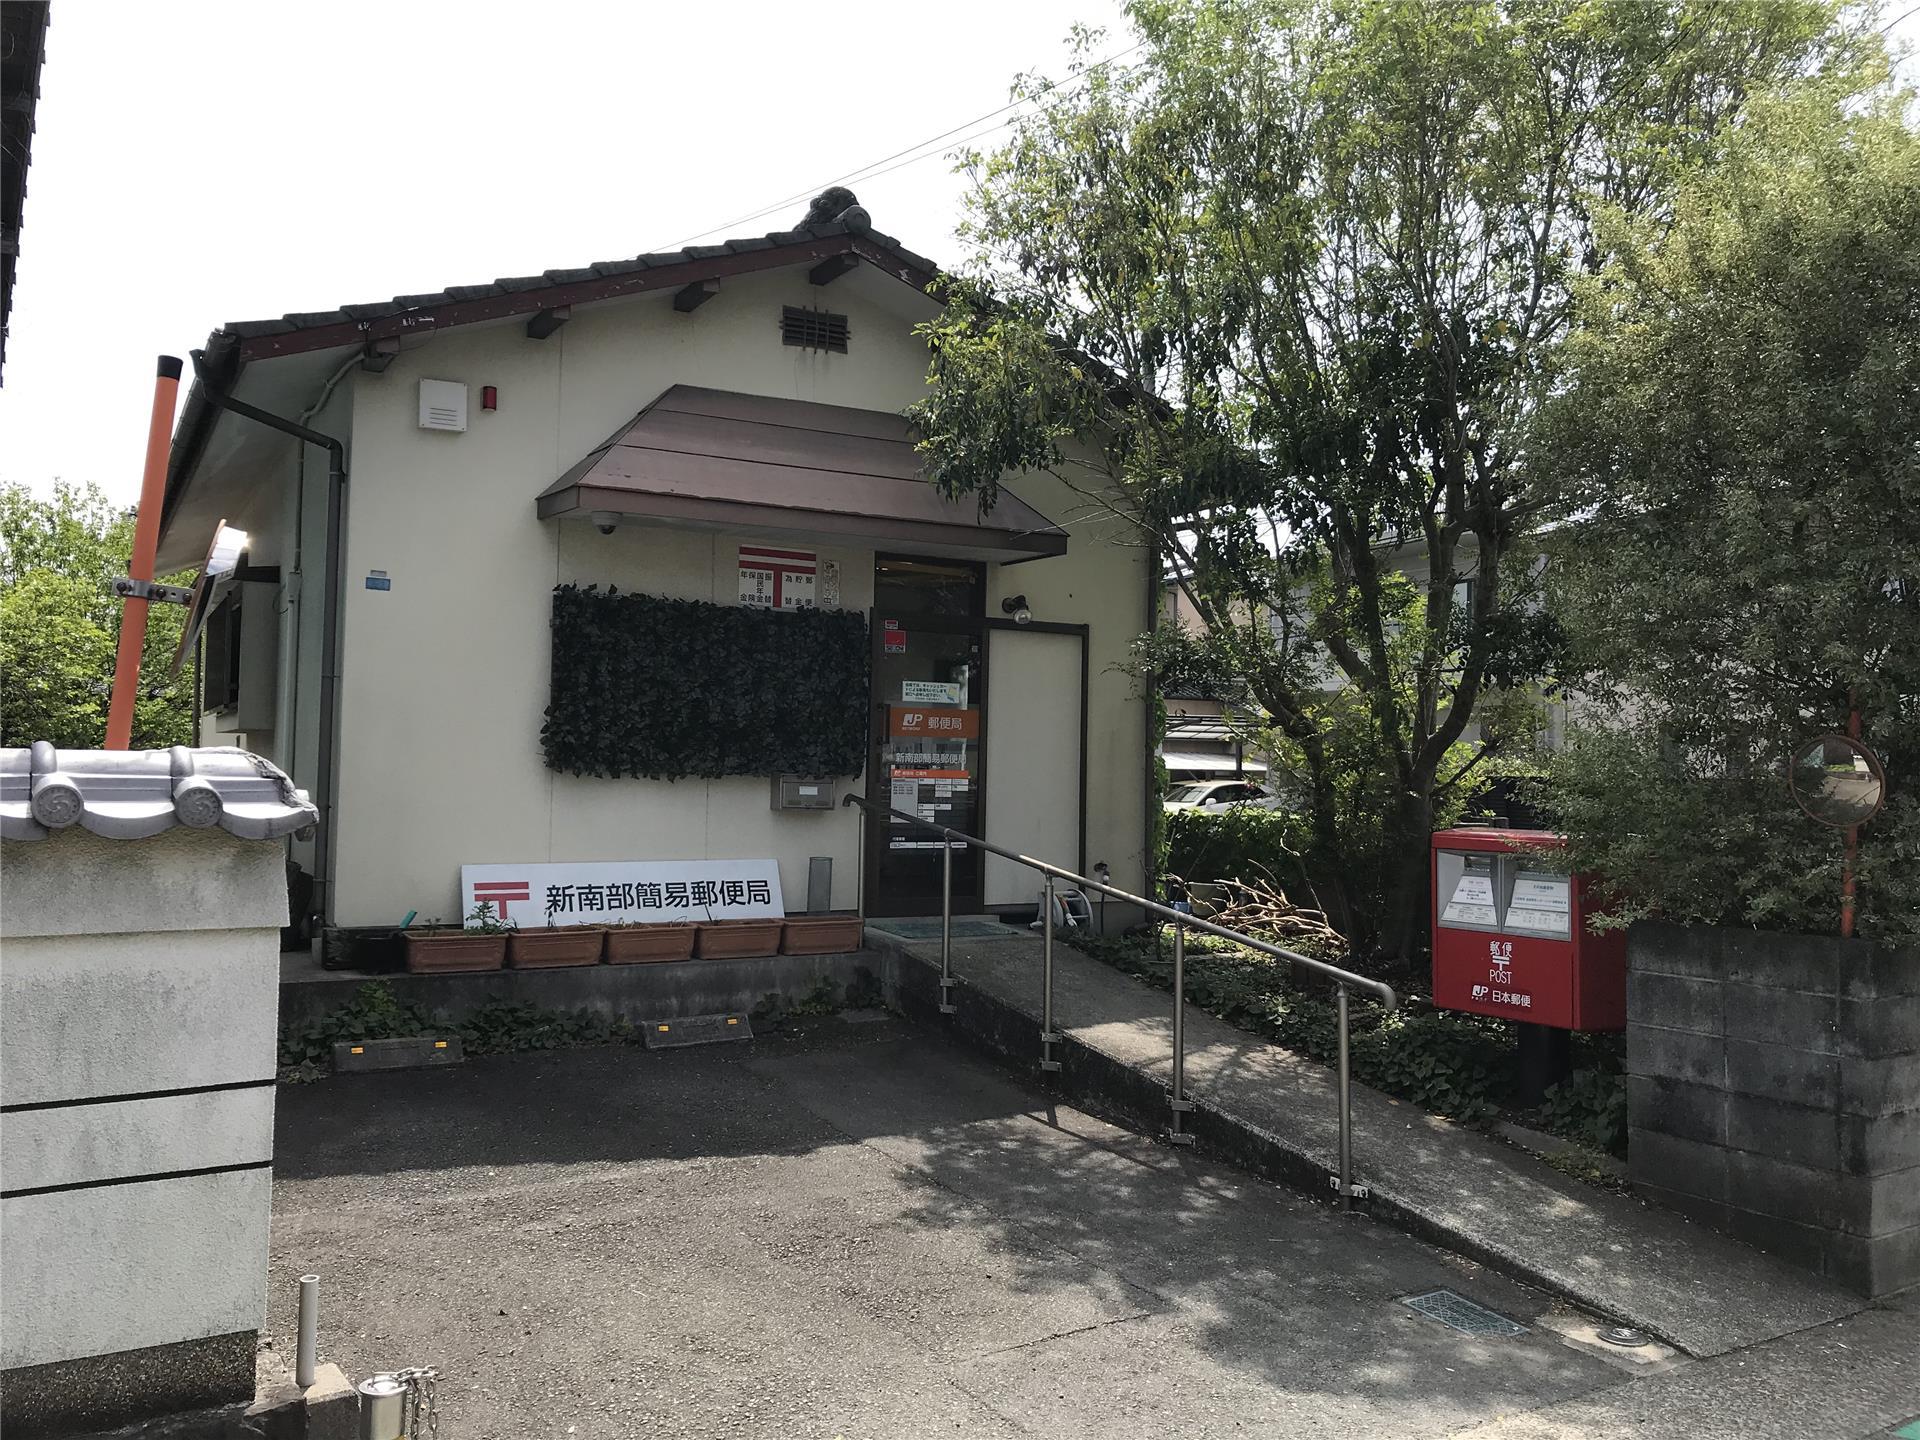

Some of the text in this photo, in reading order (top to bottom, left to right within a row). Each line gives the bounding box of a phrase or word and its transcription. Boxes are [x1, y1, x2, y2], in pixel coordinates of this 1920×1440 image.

[902, 713, 923, 726] JP
[928, 717, 962, 730] 郵便局
[895, 752, 967, 765] 新南部簡易郵便局
[545, 879, 771, 914] 新南部簡易郵便局
[1490, 941, 1512, 958] 郵便
[1489, 969, 1512, 984] POST
[1472, 985, 1531, 1008] JP 日本郵便
